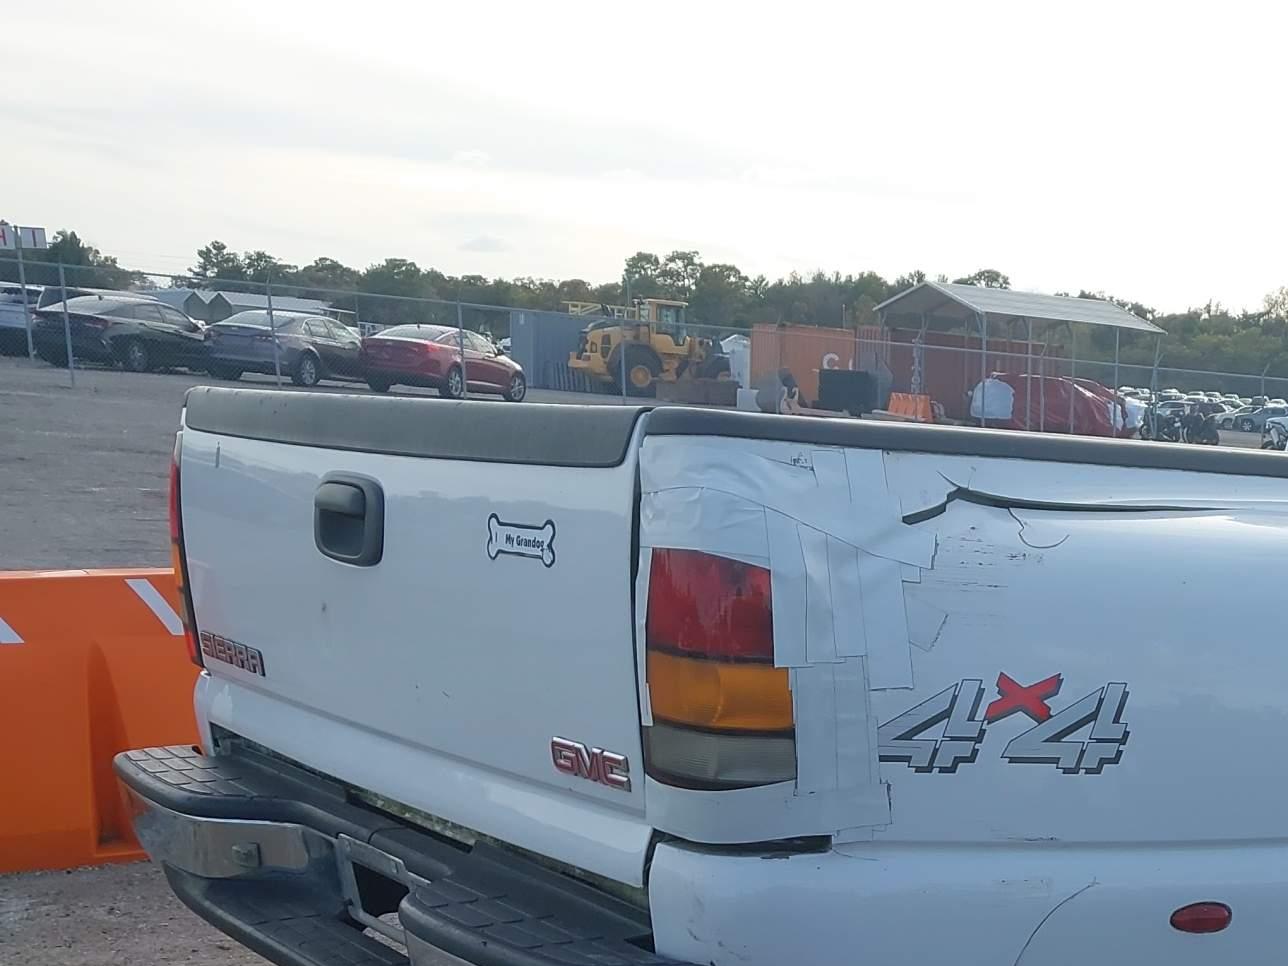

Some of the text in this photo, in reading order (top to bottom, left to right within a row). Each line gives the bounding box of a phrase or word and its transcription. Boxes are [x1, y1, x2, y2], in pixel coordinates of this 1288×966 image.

[505, 534, 514, 547] My
[200, 631, 266, 678] SIERRA
[551, 736, 631, 793] GMC
